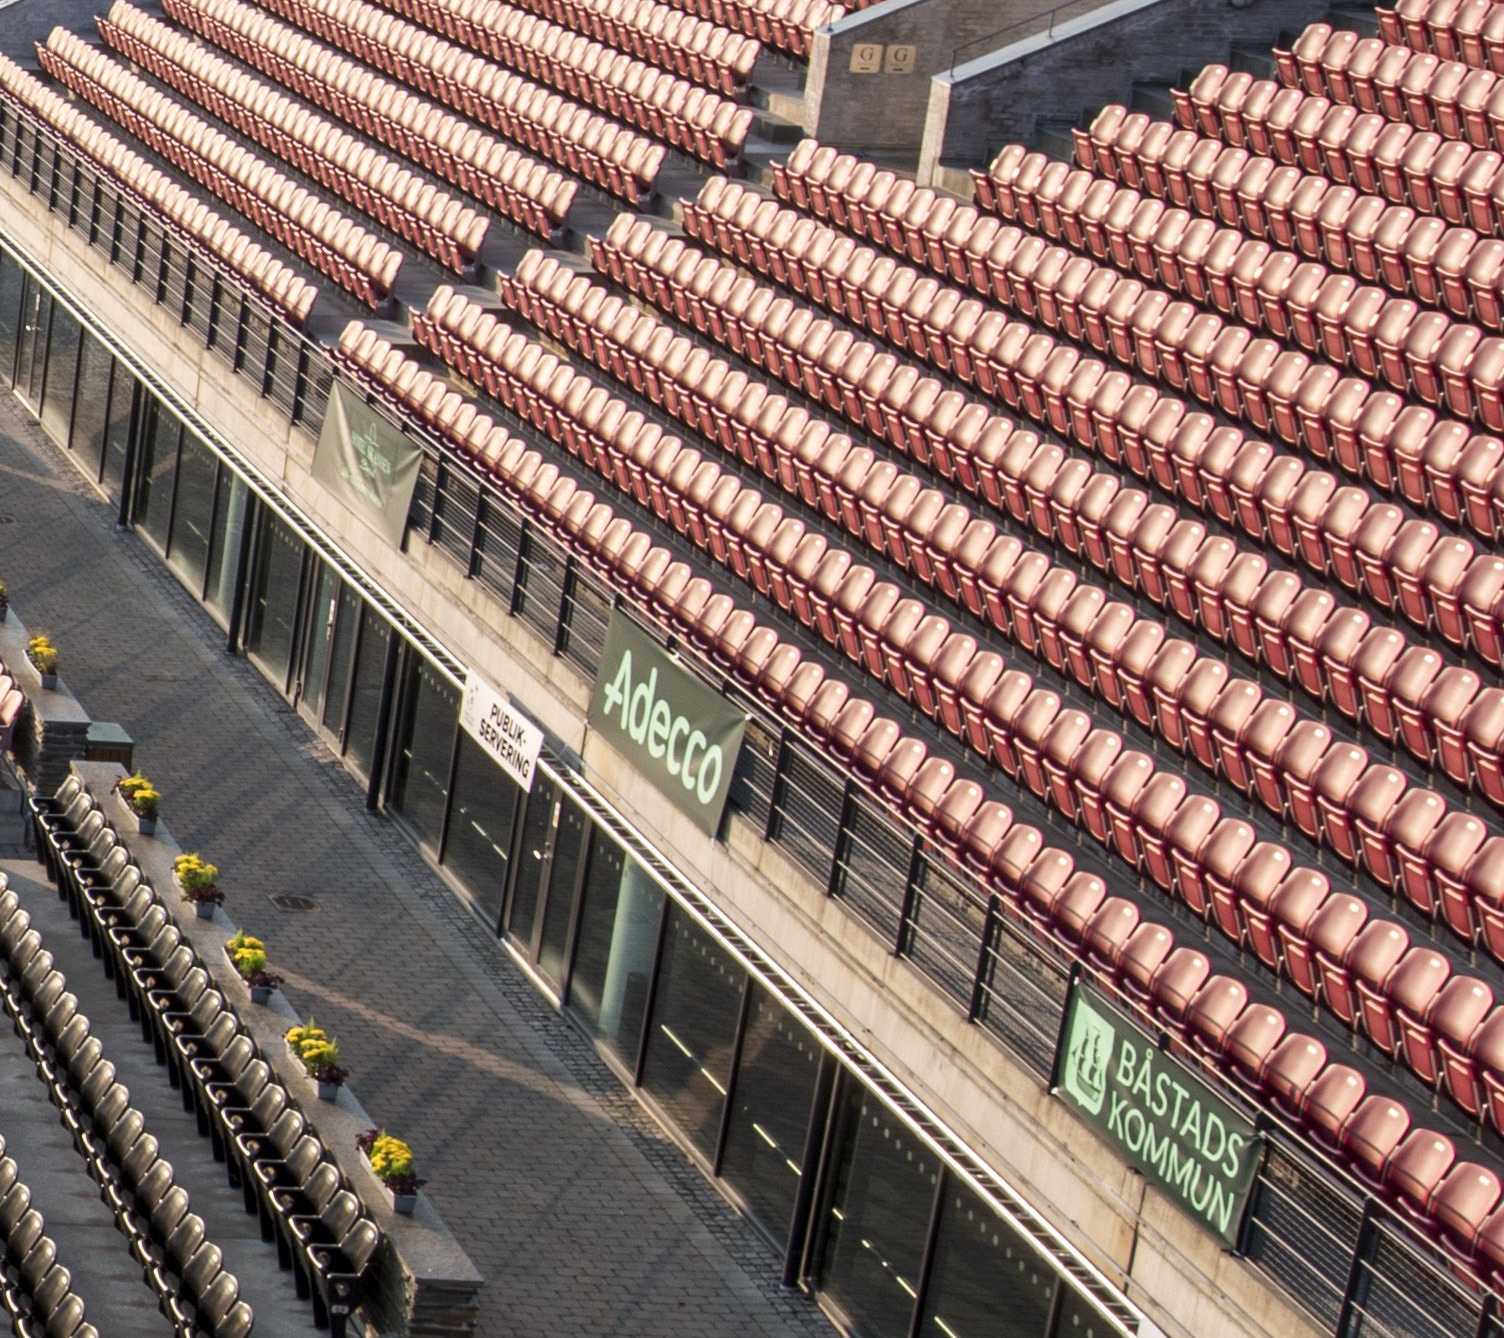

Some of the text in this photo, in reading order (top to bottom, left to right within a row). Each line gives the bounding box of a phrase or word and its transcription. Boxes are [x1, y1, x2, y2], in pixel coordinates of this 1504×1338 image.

[479, 718, 530, 779] SERVERING
[603, 649, 723, 805] Adecco
[1108, 1091, 1235, 1233] KOMMUN
[1116, 1039, 1244, 1179] BÅSTADS
